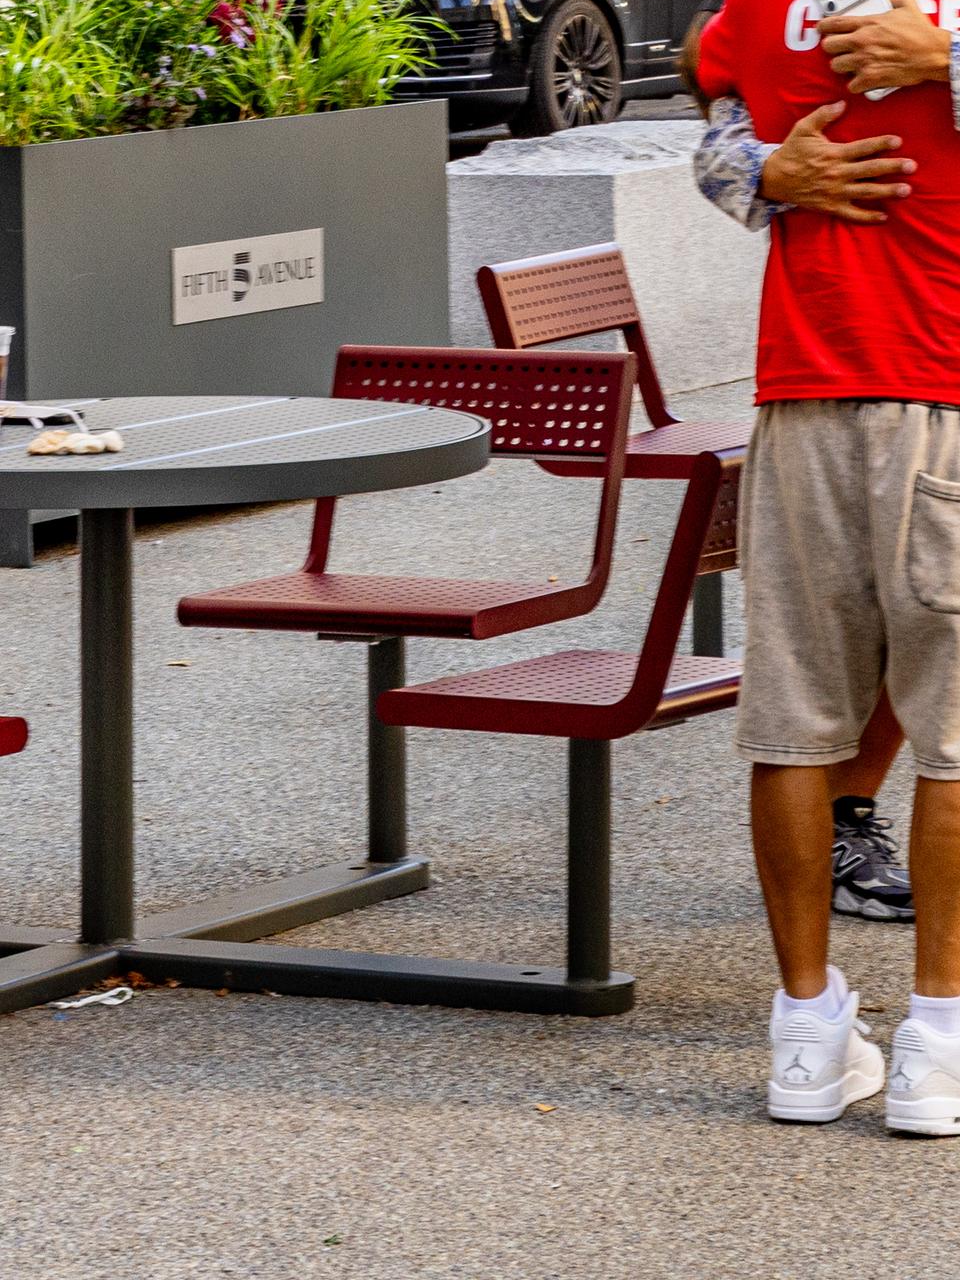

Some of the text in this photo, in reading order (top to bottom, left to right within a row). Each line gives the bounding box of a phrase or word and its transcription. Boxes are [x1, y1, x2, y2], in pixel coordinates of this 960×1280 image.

[181, 251, 315, 302] FIFTH 5 AVENUE
